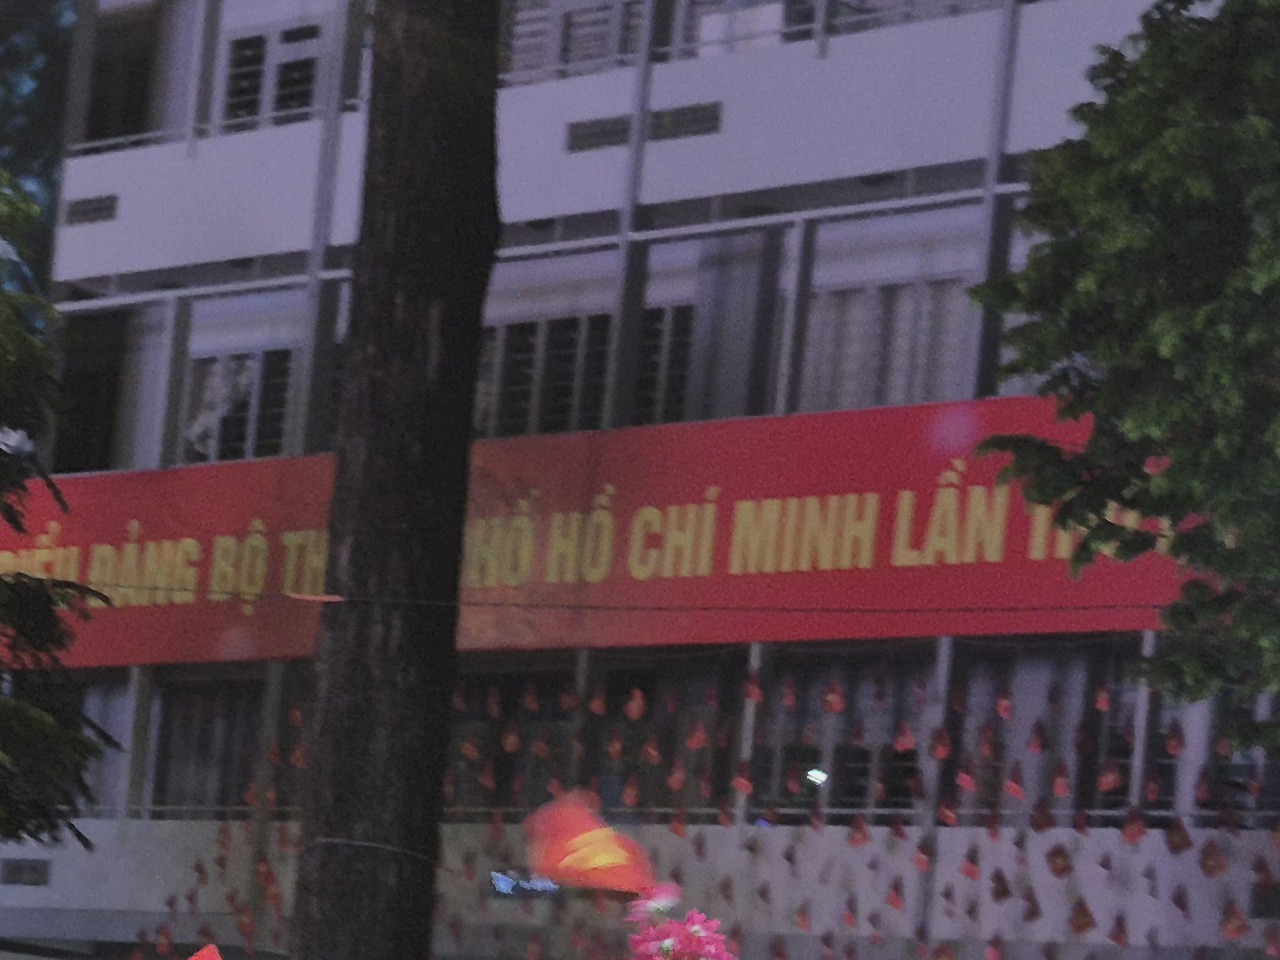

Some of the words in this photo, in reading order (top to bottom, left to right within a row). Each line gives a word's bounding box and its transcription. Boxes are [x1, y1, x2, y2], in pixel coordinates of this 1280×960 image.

[208, 517, 269, 617] BỘ
[546, 483, 616, 584] HỒ
[628, 485, 721, 581] CHÍ
[728, 491, 880, 575] MINH
[891, 457, 1011, 567] LẦN
